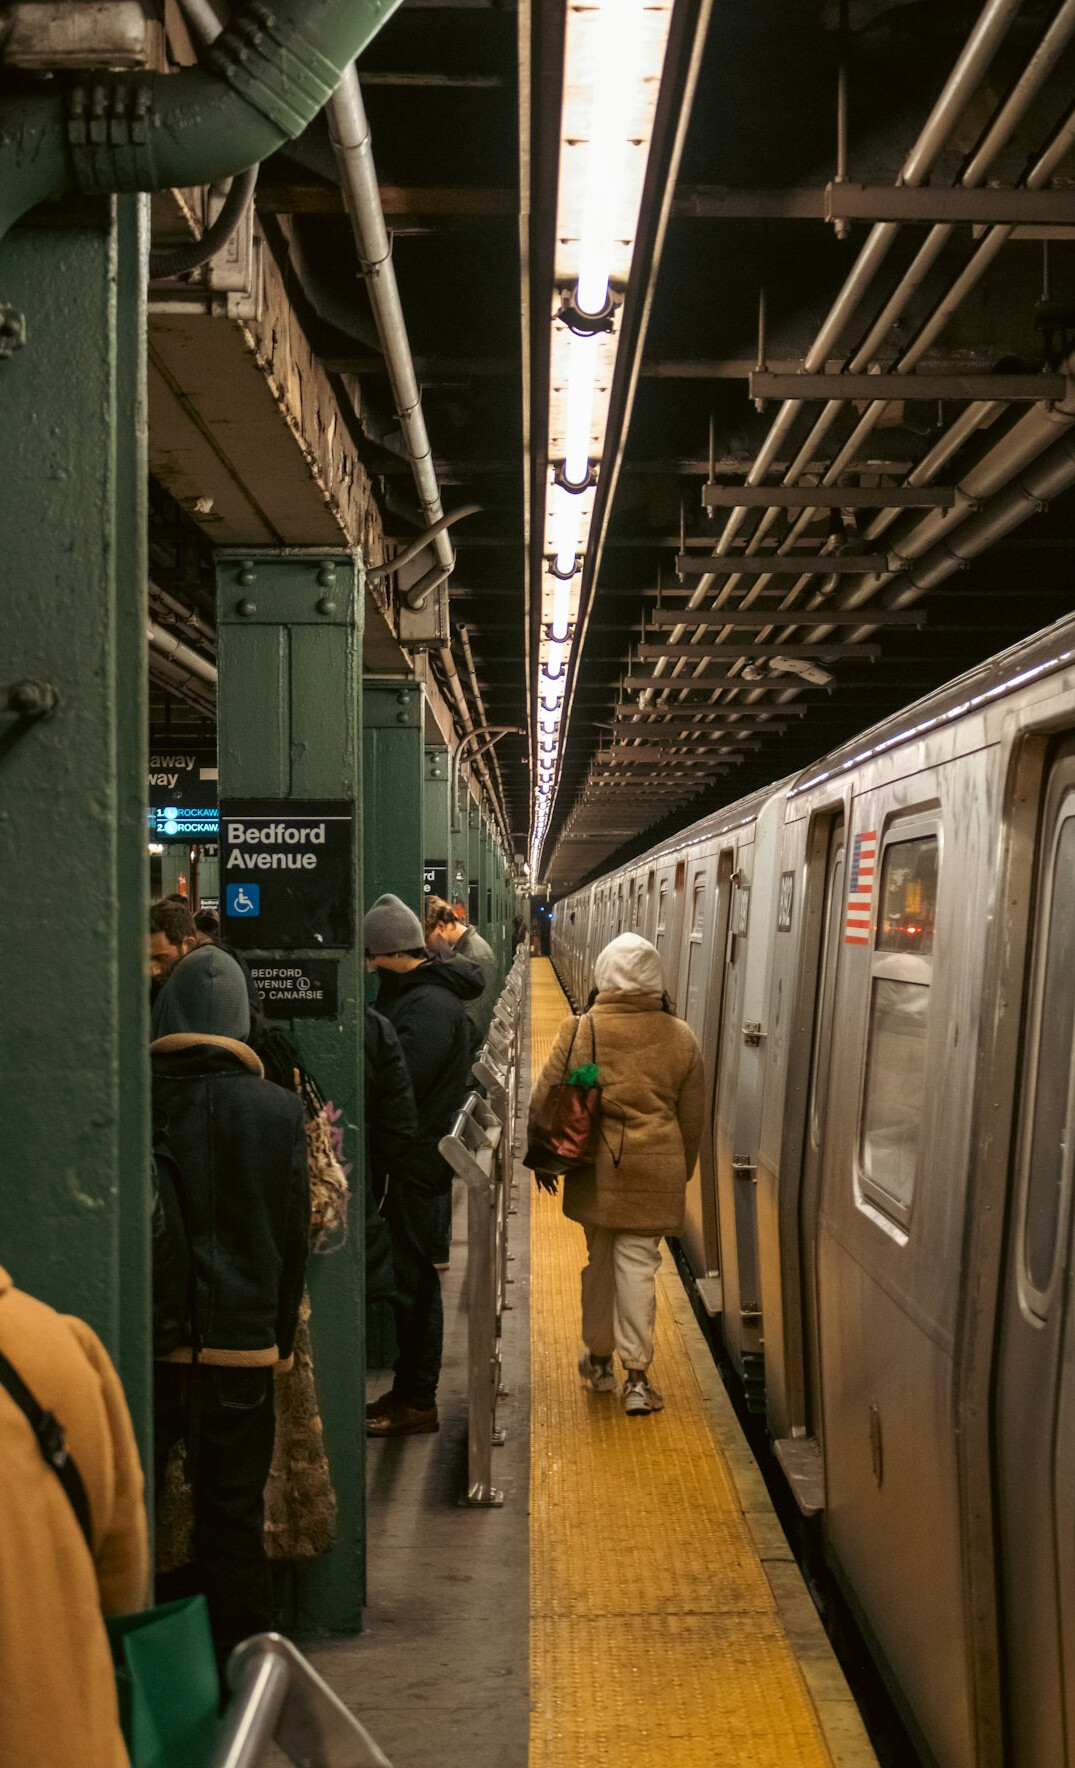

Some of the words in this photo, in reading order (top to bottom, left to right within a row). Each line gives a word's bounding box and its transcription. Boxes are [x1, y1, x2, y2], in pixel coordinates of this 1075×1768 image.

[227, 823, 326, 844] Bedford
[226, 849, 317, 869] Avenue
[251, 968, 302, 977] BEDFORD
[269, 990, 323, 999] CANARSIE
